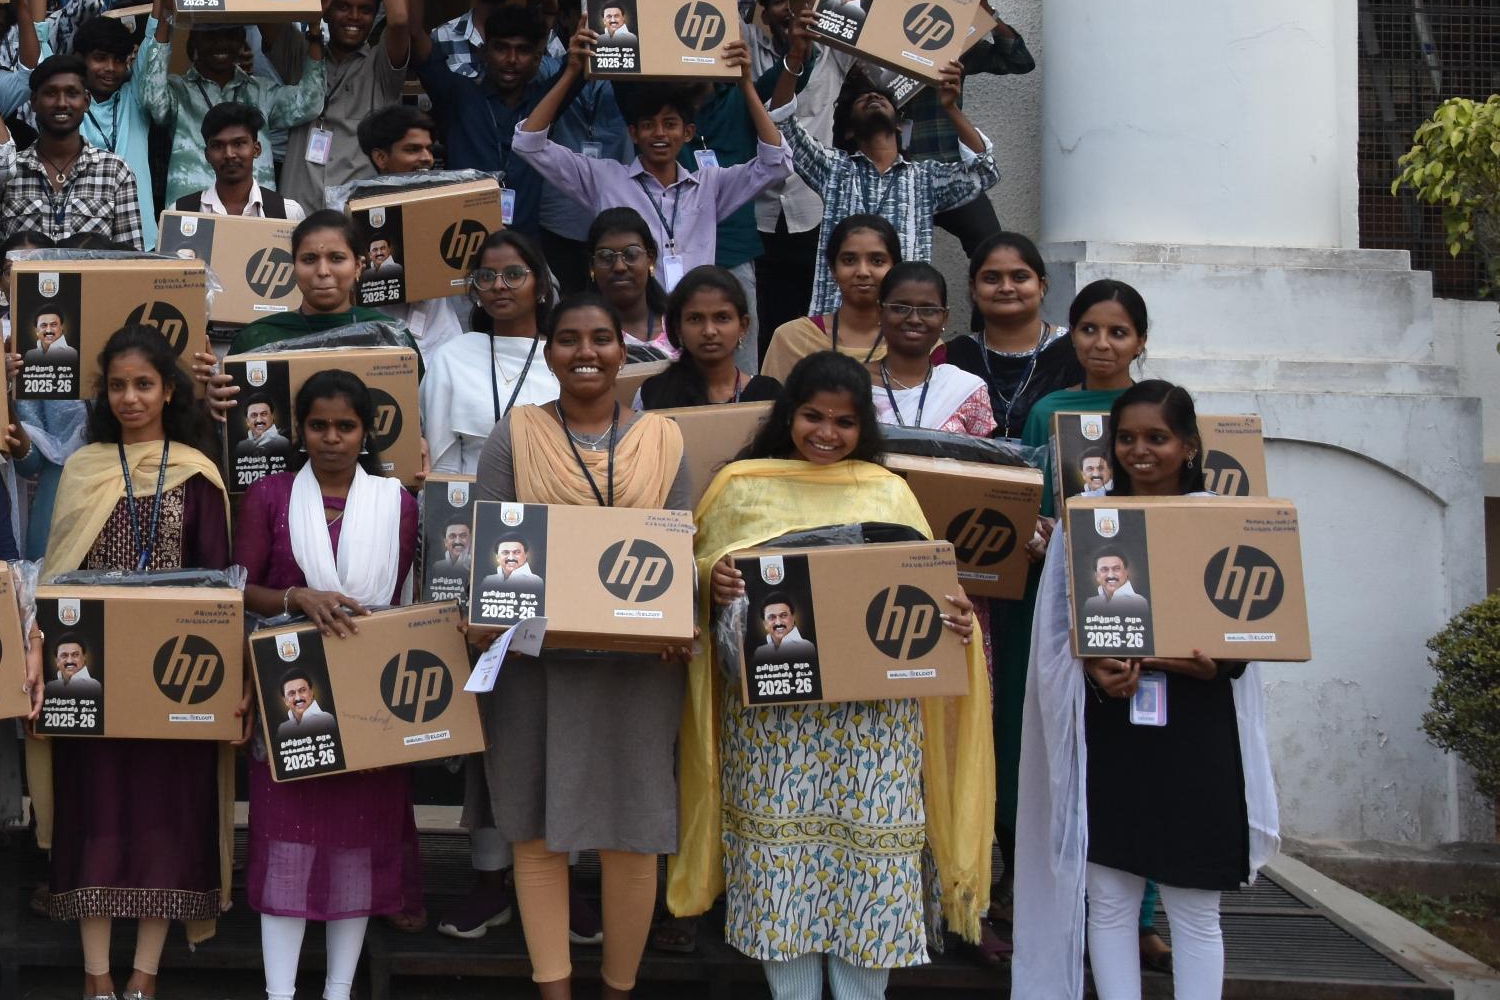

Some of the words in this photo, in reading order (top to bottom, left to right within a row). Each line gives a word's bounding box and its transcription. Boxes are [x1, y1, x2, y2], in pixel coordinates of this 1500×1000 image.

[681, 1, 721, 51] hp
[818, 18, 855, 40] 2025-26
[906, 2, 952, 49] hp
[597, 56, 635, 69] 2025-26
[895, 79, 921, 101] 2025-2
[446, 220, 486, 270] hp
[250, 247, 295, 299] hp
[362, 288, 400, 304] 2025-26
[24, 377, 73, 394] 2025-26
[957, 509, 1012, 567] hp
[607, 539, 667, 602] hp
[1214, 545, 1276, 621] hp
[481, 603, 537, 621] 2025-26
[876, 585, 935, 661] hp
[1087, 630, 1144, 650] 2025-26
[161, 634, 218, 705] hp
[391, 650, 444, 723] hp
[757, 677, 814, 697] 2025-26
[45, 711, 96, 730] 2025-26
[282, 748, 338, 772] 2025-26
